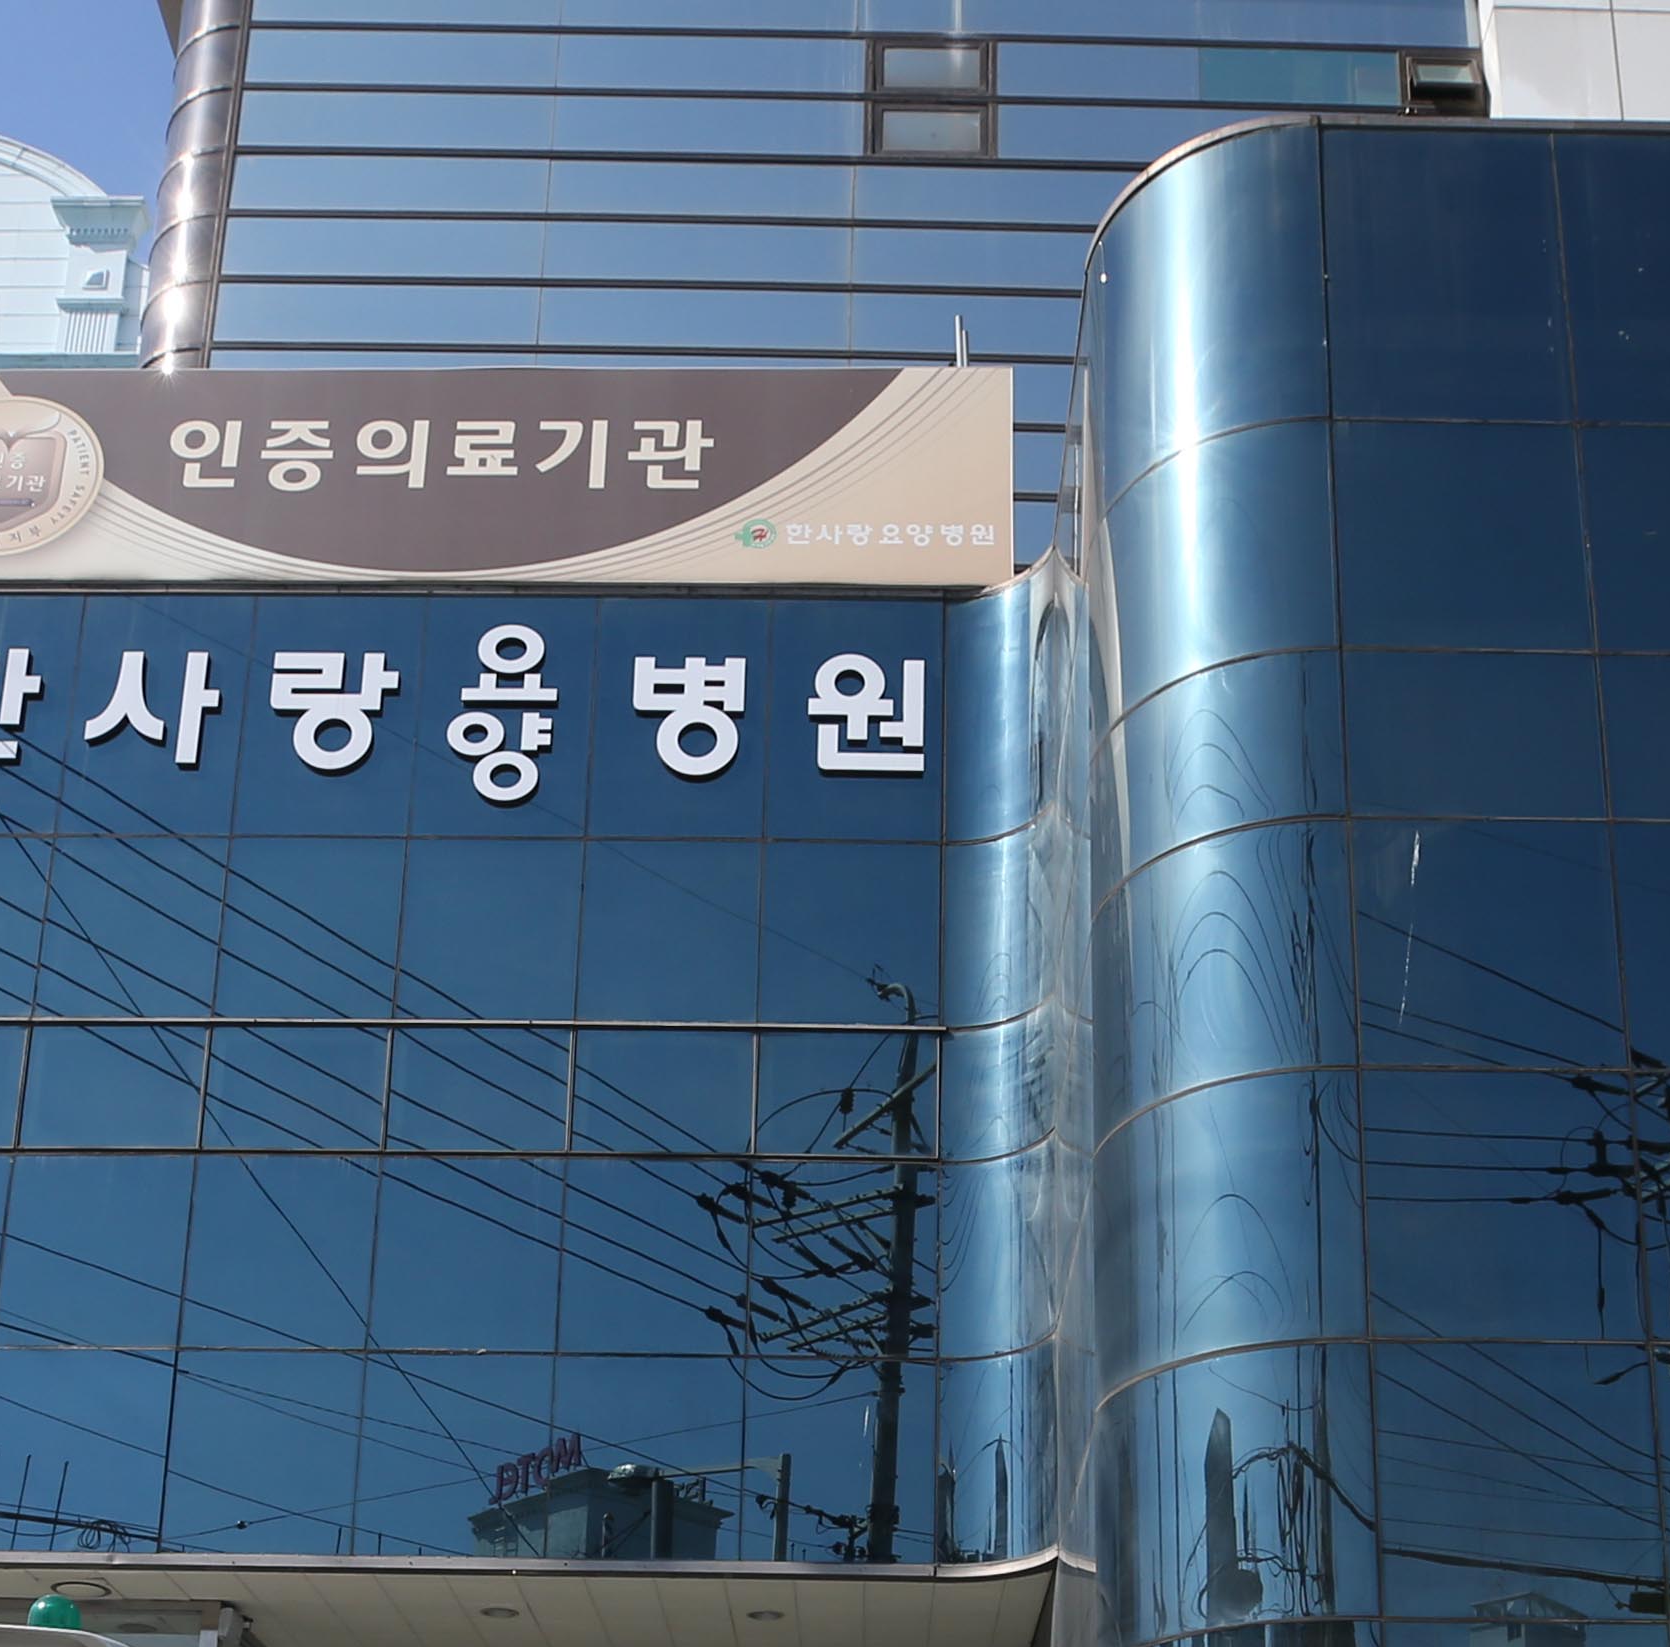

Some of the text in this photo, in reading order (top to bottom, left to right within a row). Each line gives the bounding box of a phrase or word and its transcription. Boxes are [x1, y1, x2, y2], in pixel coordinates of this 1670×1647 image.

[50, 429, 90, 524] PATIENT SAFETY
[166, 414, 717, 497] 인증의료기관
[785, 523, 995, 546] 한사랑요양병원
